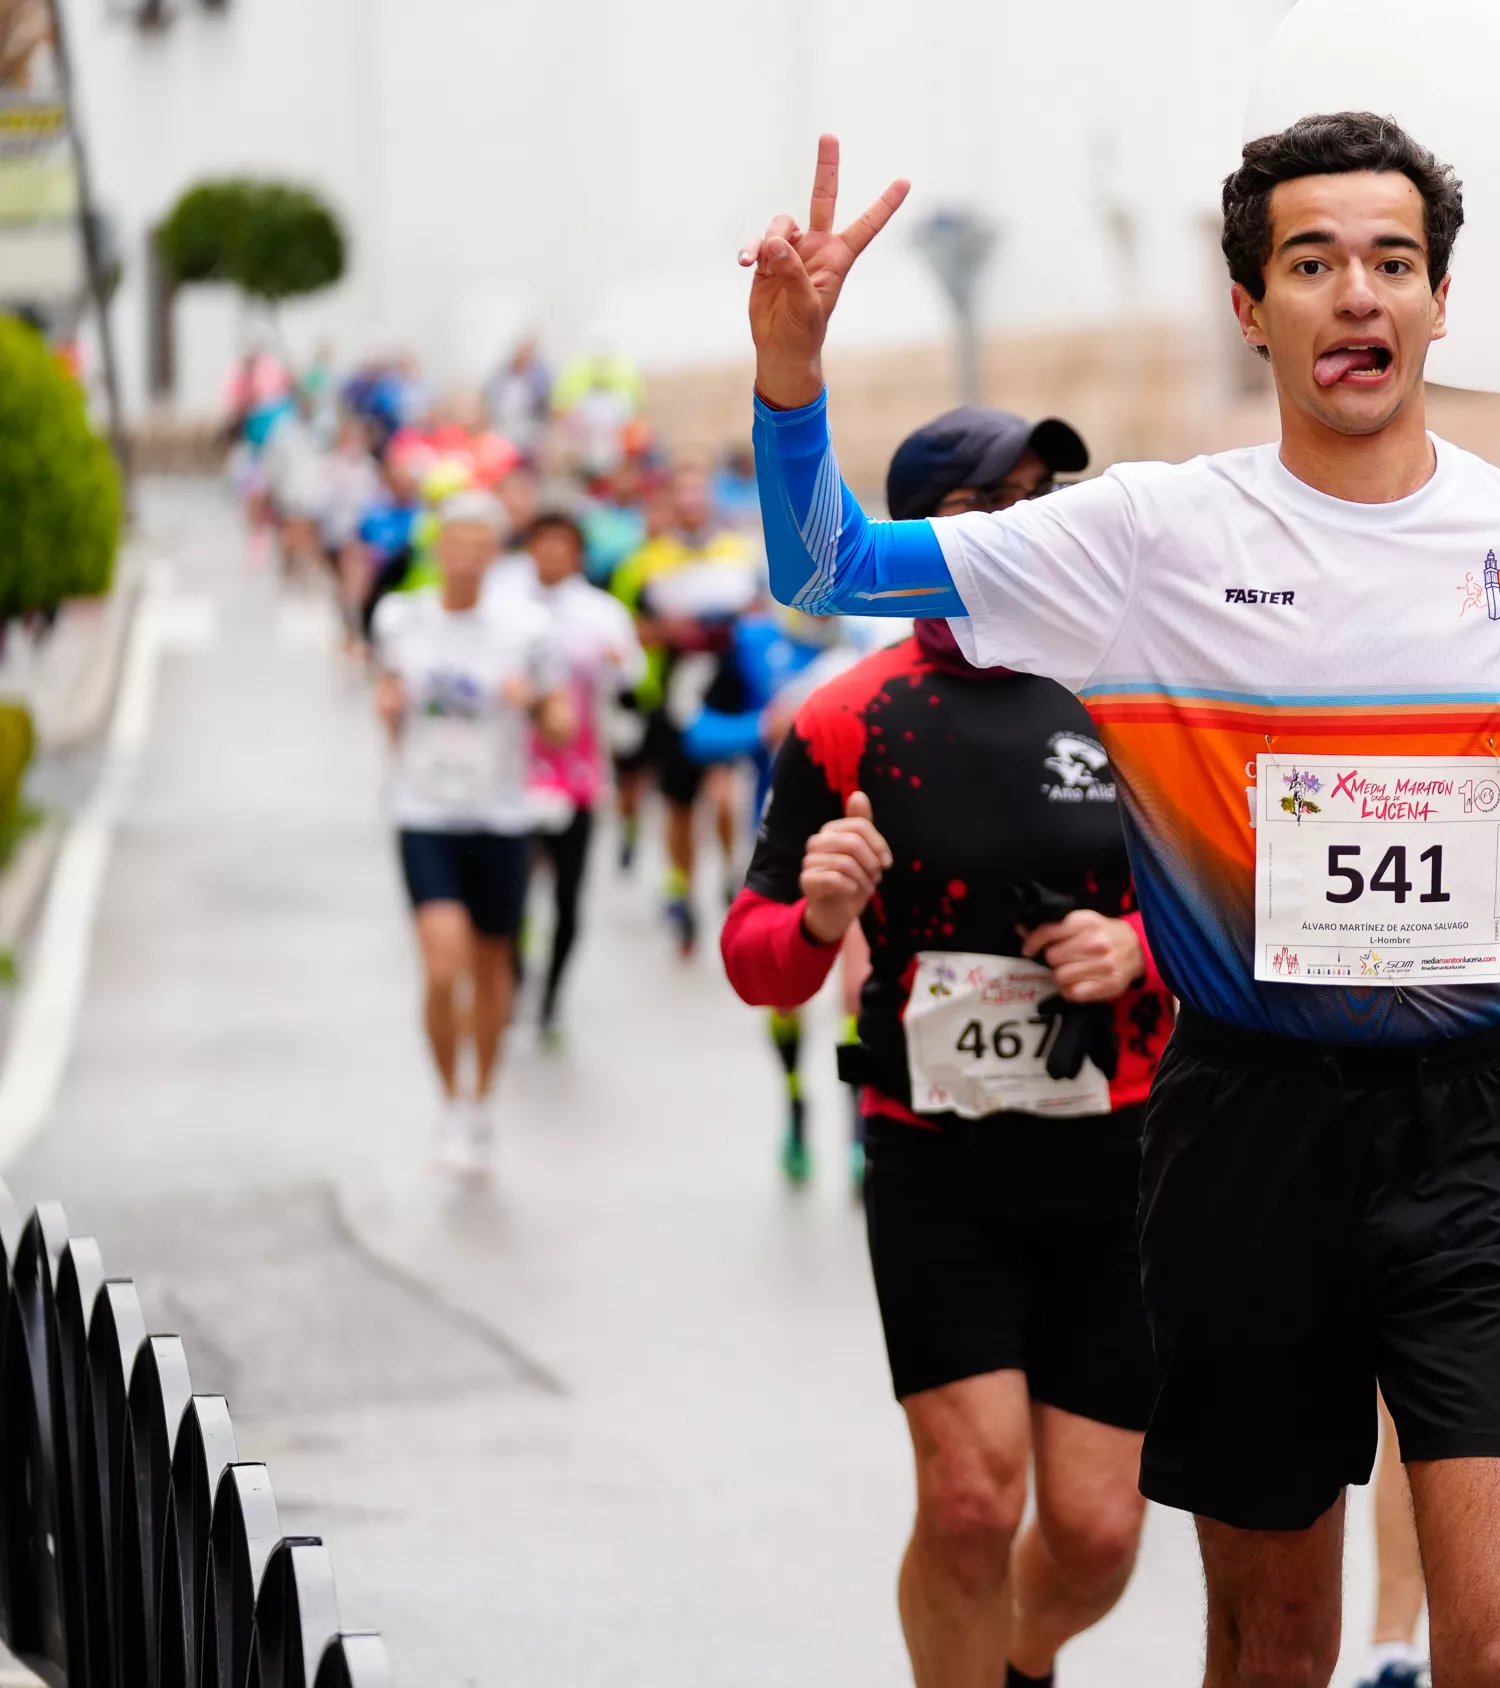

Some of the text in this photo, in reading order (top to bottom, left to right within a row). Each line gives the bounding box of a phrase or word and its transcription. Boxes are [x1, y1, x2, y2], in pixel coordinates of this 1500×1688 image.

[1225, 588, 1295, 605] FASTER
[1395, 778, 1454, 796] MARATÓN
[1361, 797, 1439, 821] LUCENA
[1325, 844, 1451, 904] 541
[1302, 921, 1469, 932] ÁLVARO MARTÍNEZ DE AZCONA SALVAGO
[1370, 936, 1411, 944] L-Hombre
[1421, 956, 1496, 964] mediamaratonlucena.com
[956, 1016, 1056, 1059] 467
